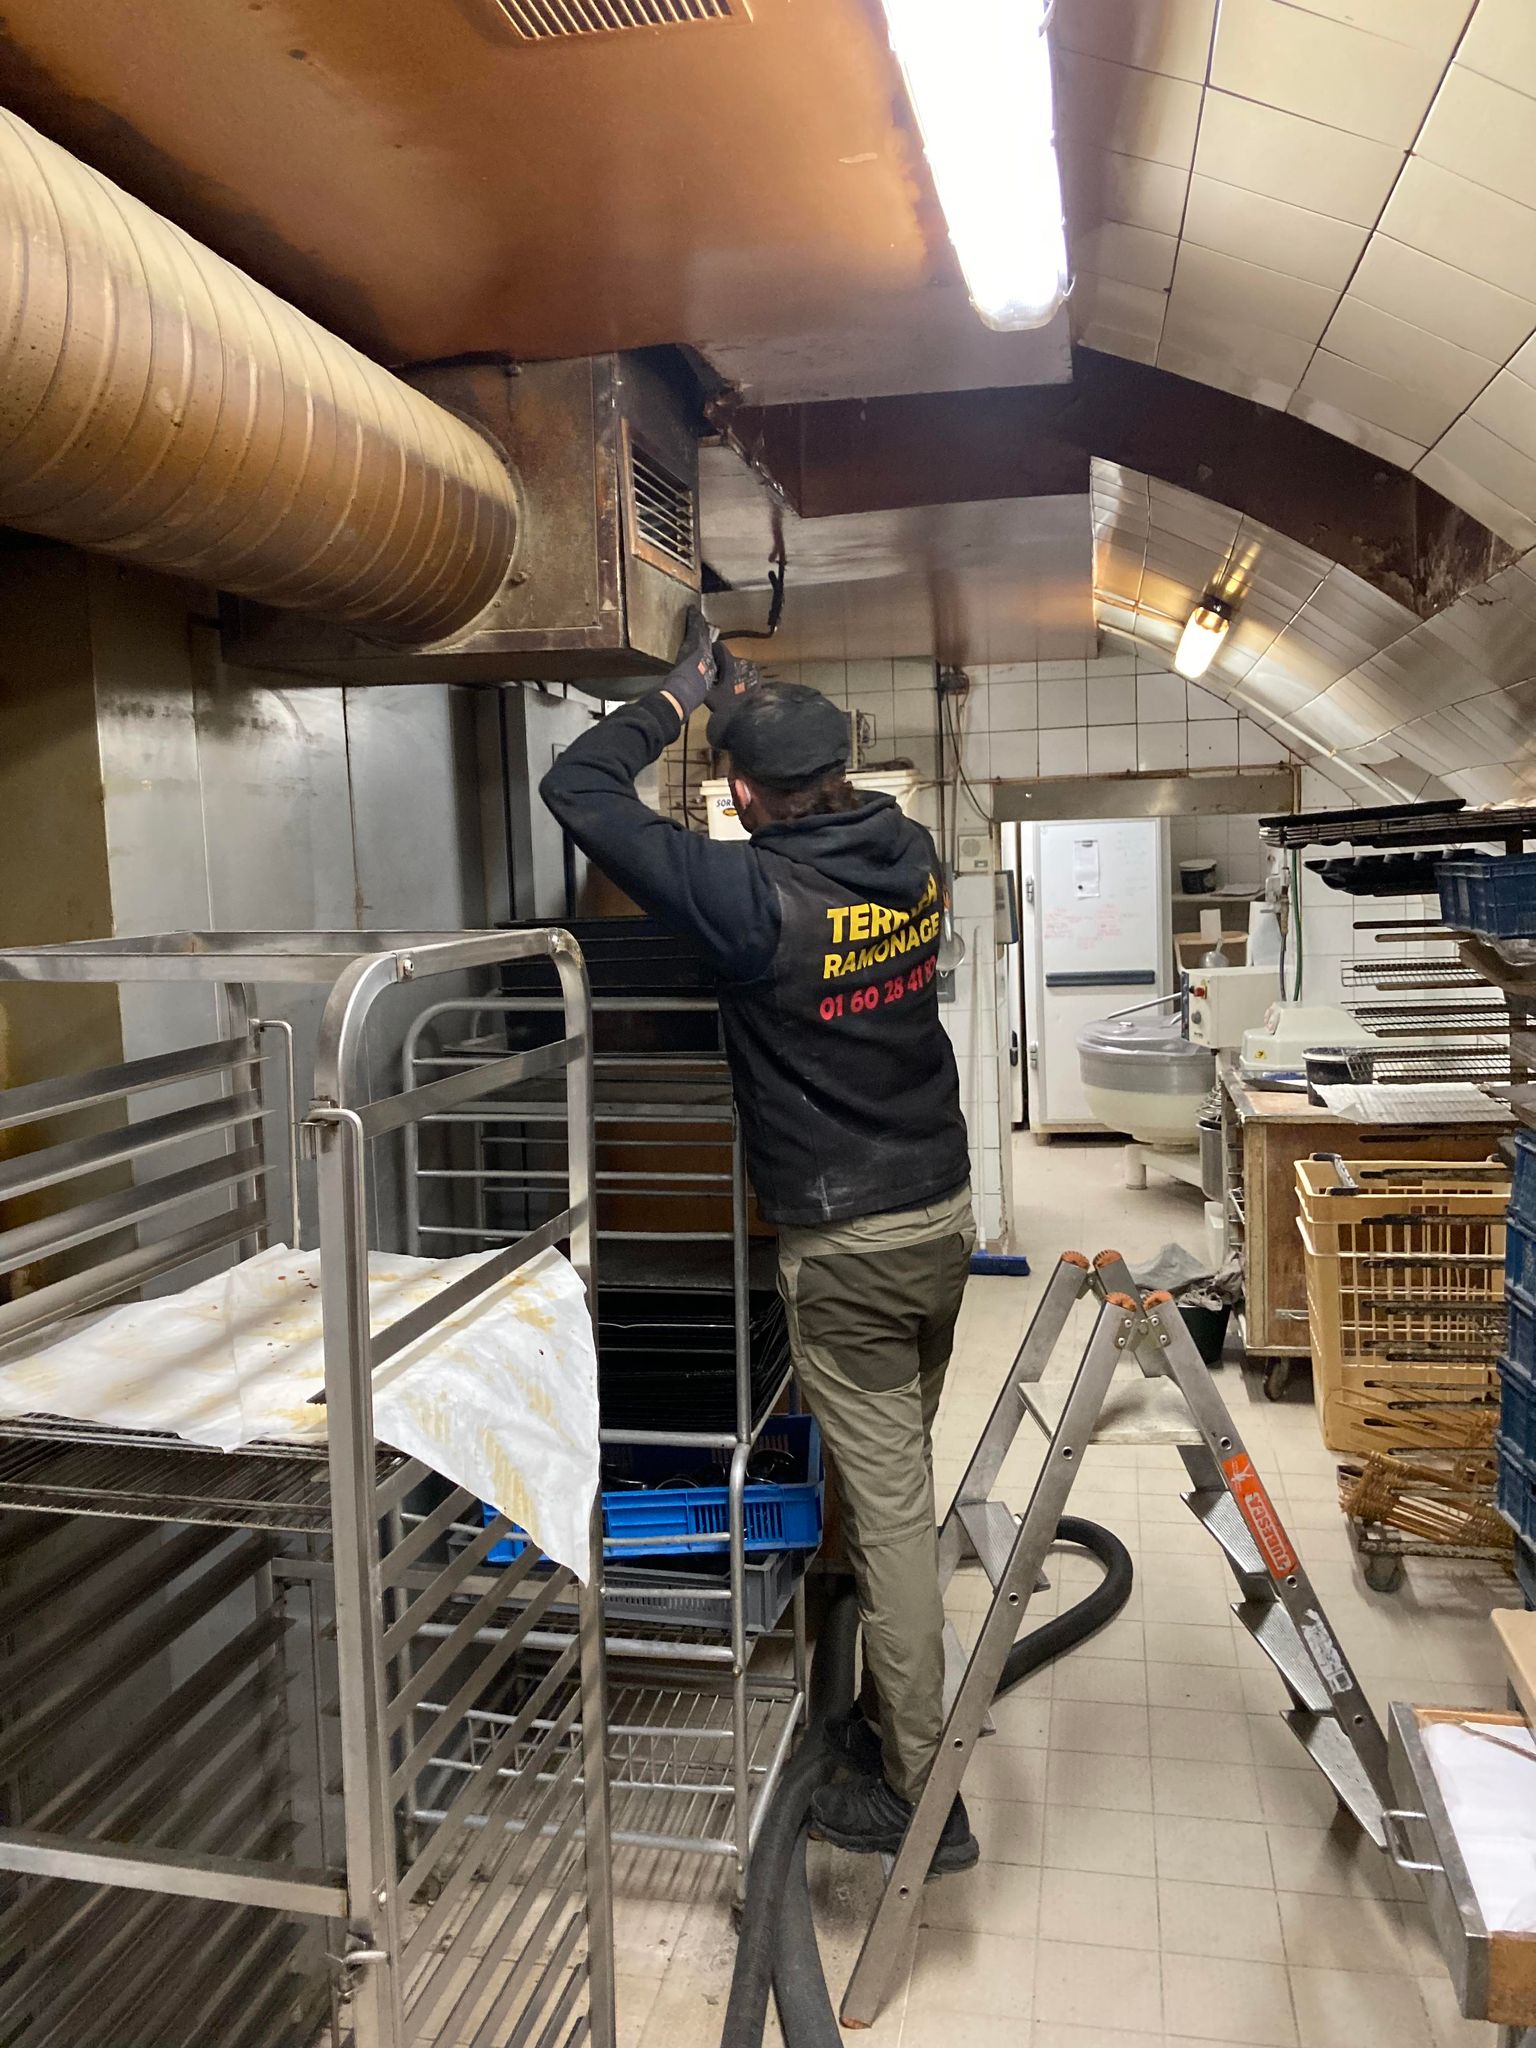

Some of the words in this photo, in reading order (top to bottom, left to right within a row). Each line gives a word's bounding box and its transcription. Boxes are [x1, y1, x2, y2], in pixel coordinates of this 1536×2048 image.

[716, 798, 734, 807] SOR
[823, 911, 940, 980] RAMONAGE
[819, 994, 844, 1021] 01
[850, 986, 879, 1013] 60
[884, 976, 905, 1004] 28
[907, 966, 924, 992] 41
[1249, 1494, 1291, 1571] TUBESCA
